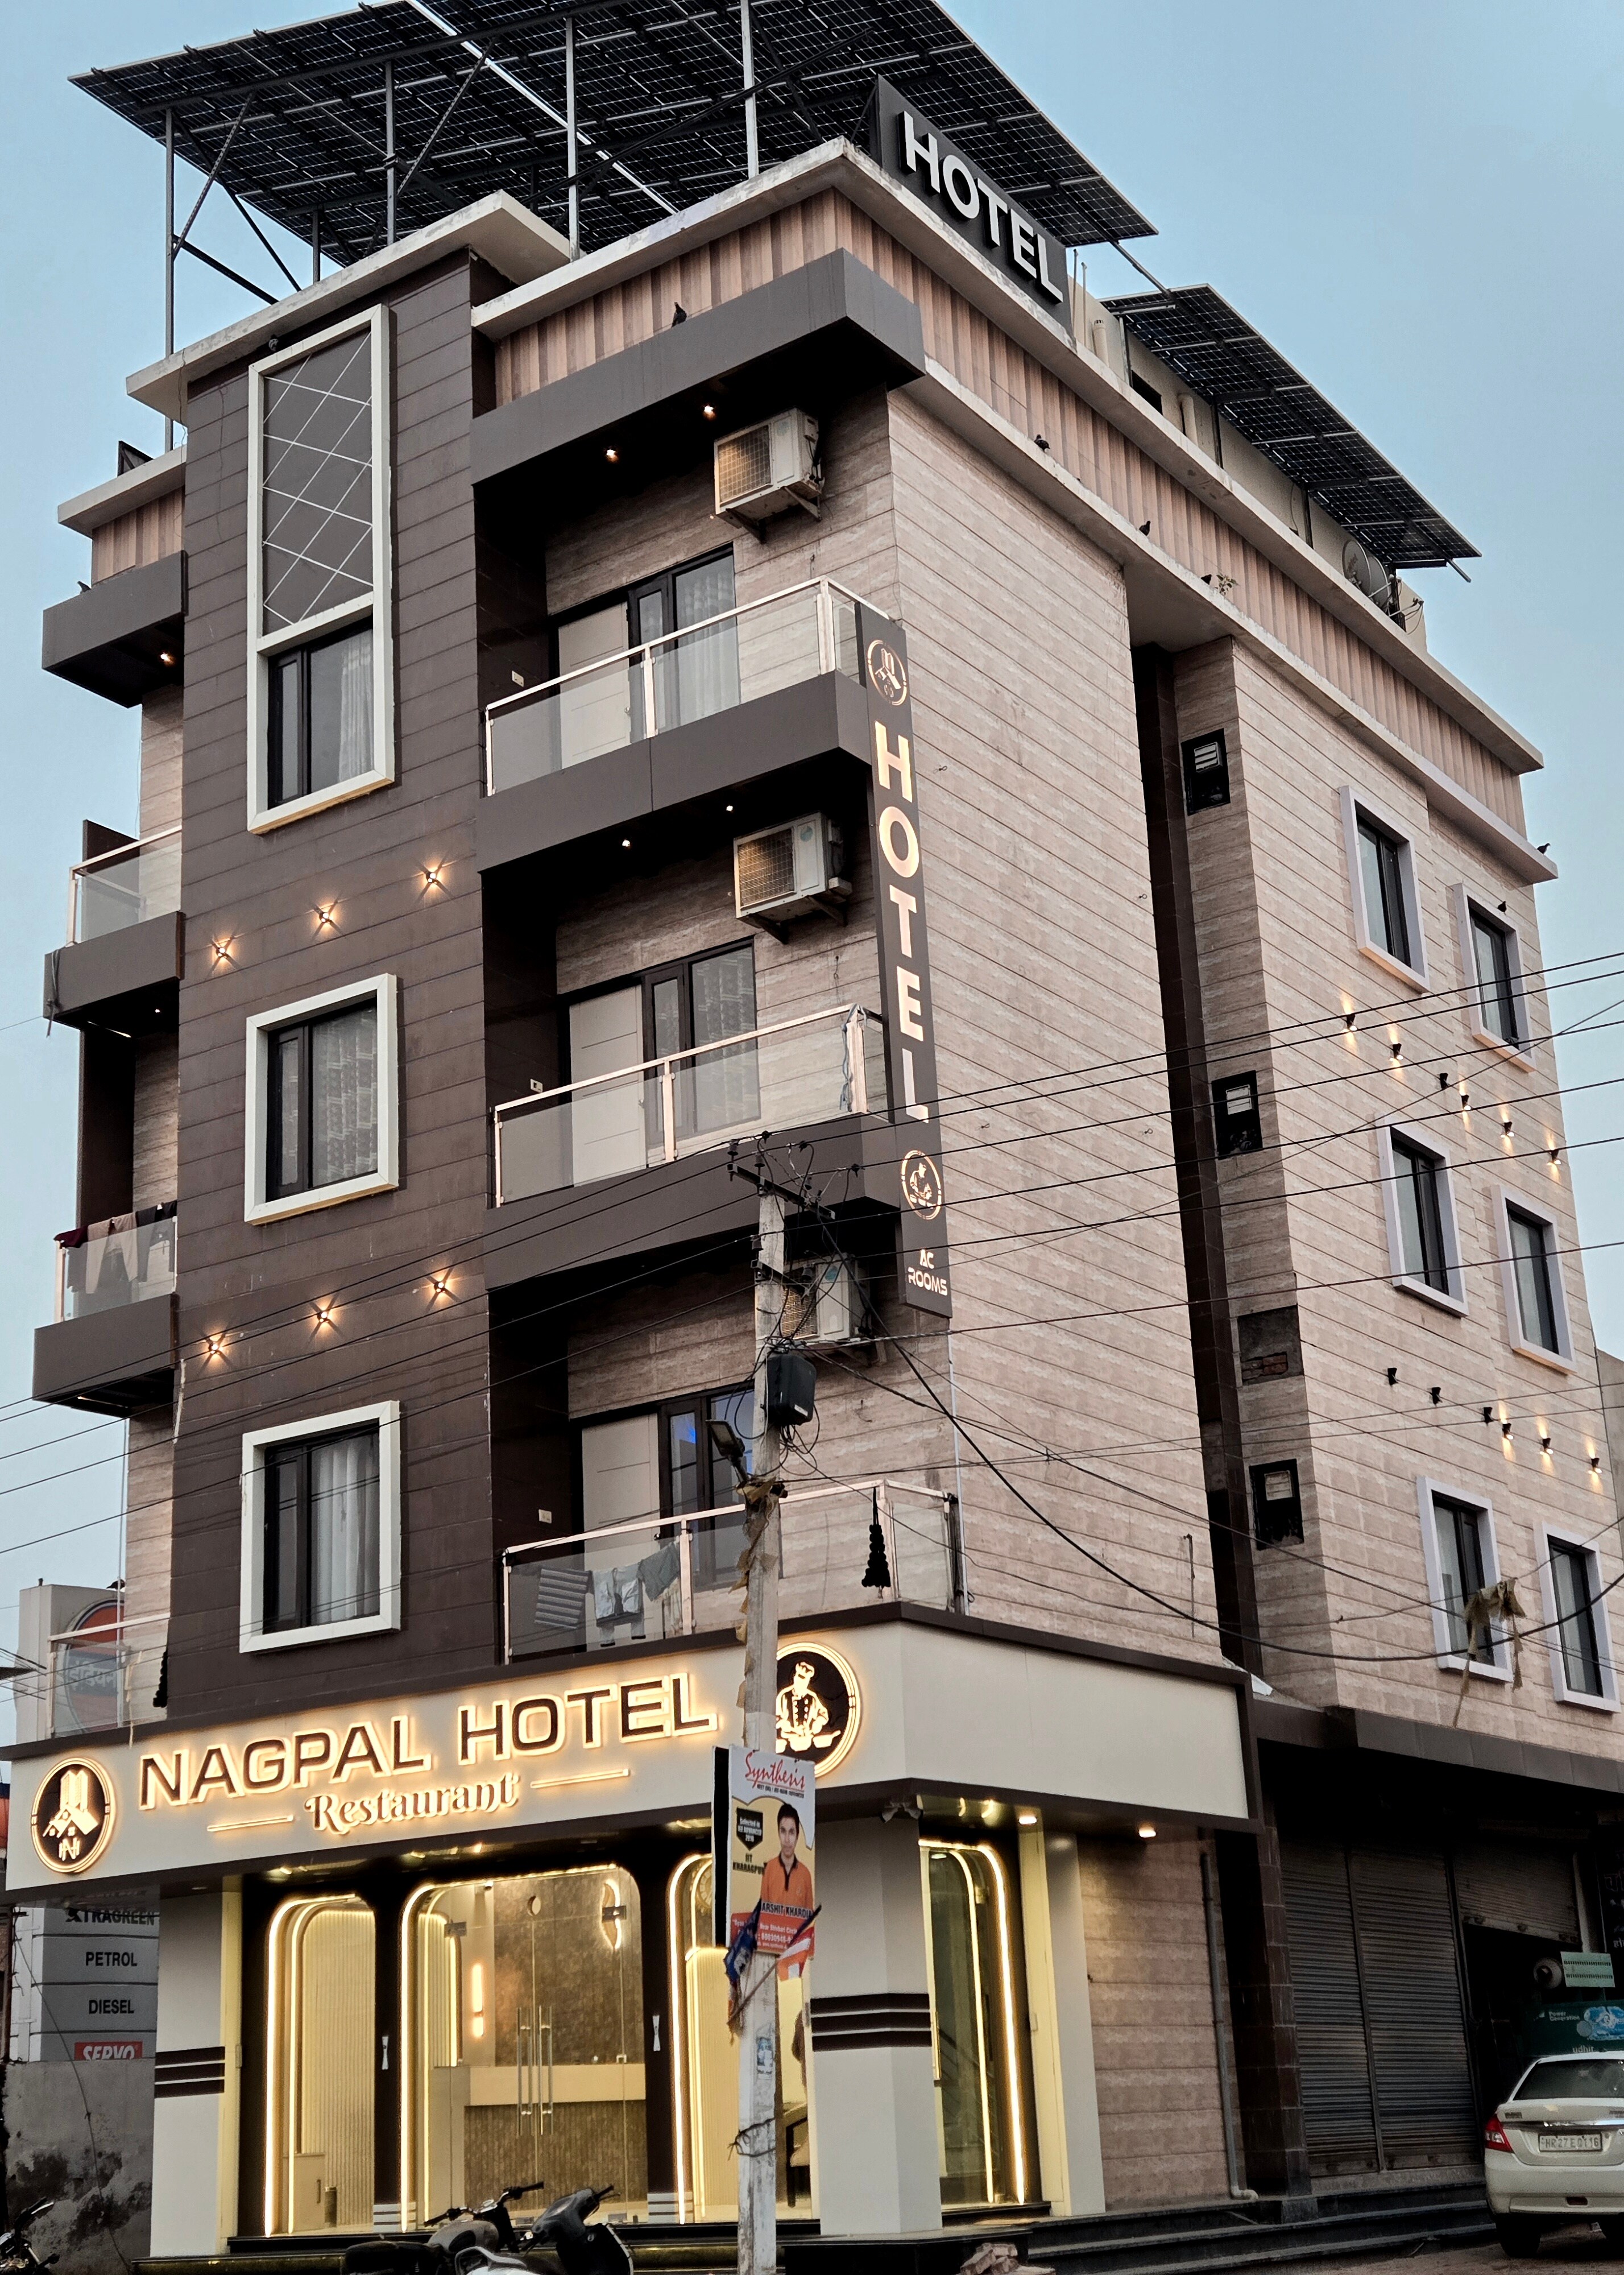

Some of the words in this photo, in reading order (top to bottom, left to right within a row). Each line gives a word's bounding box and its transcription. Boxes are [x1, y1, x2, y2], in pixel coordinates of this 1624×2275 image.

[900, 110, 1063, 303] HOTEL
[875, 721, 929, 1124] HOTEL
[919, 1248, 934, 1269] AC
[908, 1266, 948, 1297] ROOMS
[139, 1714, 432, 1811] NAGPAL
[458, 1672, 718, 1767] HOTEL
[744, 1751, 805, 1789] Synthesis
[304, 1772, 520, 1835] Restaurant
[85, 1951, 138, 1967] PETROL
[89, 1999, 135, 2014] DIESEL
